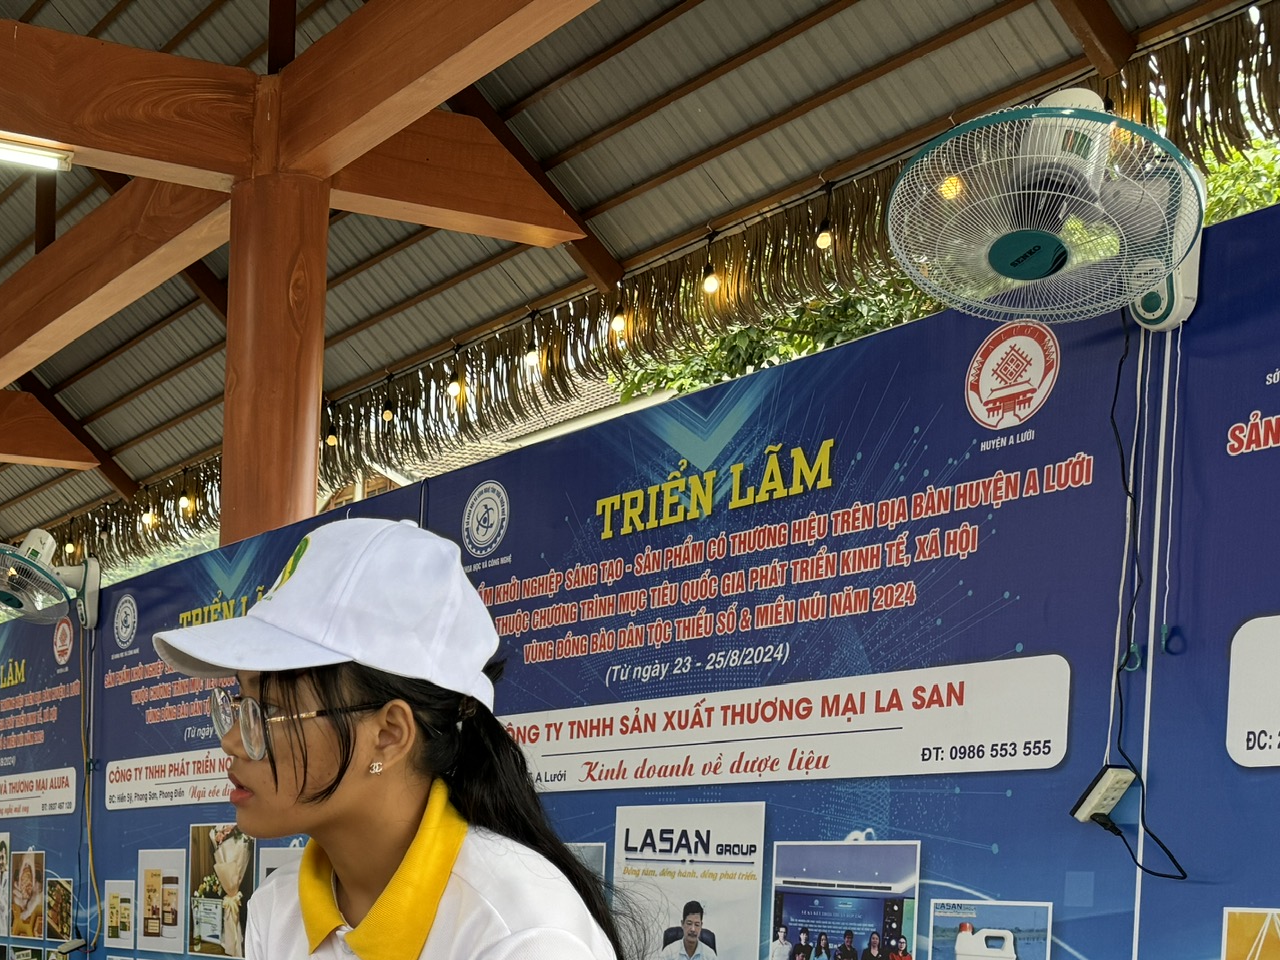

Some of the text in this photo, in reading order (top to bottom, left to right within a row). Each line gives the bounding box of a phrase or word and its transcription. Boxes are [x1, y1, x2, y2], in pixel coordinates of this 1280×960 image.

[980, 437, 1007, 451] HUYỆN
[1008, 435, 1015, 446] A
[596, 459, 716, 540] TRIỂN
[729, 437, 834, 510] LÃM
[495, 575, 520, 605] KHỞI
[522, 568, 563, 599] NGHIỆP
[565, 562, 597, 591] SÁNG
[600, 557, 623, 587] TẠO
[634, 549, 663, 576] SẢN
[664, 535, 704, 570] PHẨM
[706, 534, 726, 562] CÓ
[729, 523, 788, 557] THƯƠNG
[791, 513, 828, 548] HIỆU
[831, 501, 874, 536] TRÊN
[877, 495, 908, 532] ĐỊA
[911, 484, 950, 520] BÀN
[954, 471, 1021, 512] HUYỆN
[1022, 470, 1040, 498] A
[1044, 452, 1094, 489] LƯỚI
[495, 522, 979, 638] THUỘC CHƯƠNG TRÌNH MỤC TIÊU QUỐC GIA PHÁT TRIỂN KINH TẾ, XÃ HỘI
[524, 581, 918, 664] VÙNG ĐỒNG BÀO DÂN TỘC THIỂU SỐ & MIỀN NÚI NĂM 2024
[0, 658, 26, 689] LÃM
[605, 662, 631, 687] (Từ
[632, 660, 670, 683] ngày
[672, 655, 692, 675] 23
[705, 642, 790, 672] 25/8/2024)
[505, 681, 965, 744] ÔNG TY TNHH SẢN XUẤT THƯƠNG MẠI LA SAN
[921, 740, 1052, 762] ĐT: 0986 553 555
[1246, 731, 1272, 751] ĐC:
[108, 751, 216, 784] CÔNG TY TNHH PHÁT TRIỂN
[535, 770, 567, 783] A Lưới
[578, 748, 831, 783] Kinh doanh về dược liệu
[624, 828, 757, 856] LASAN GROUP
